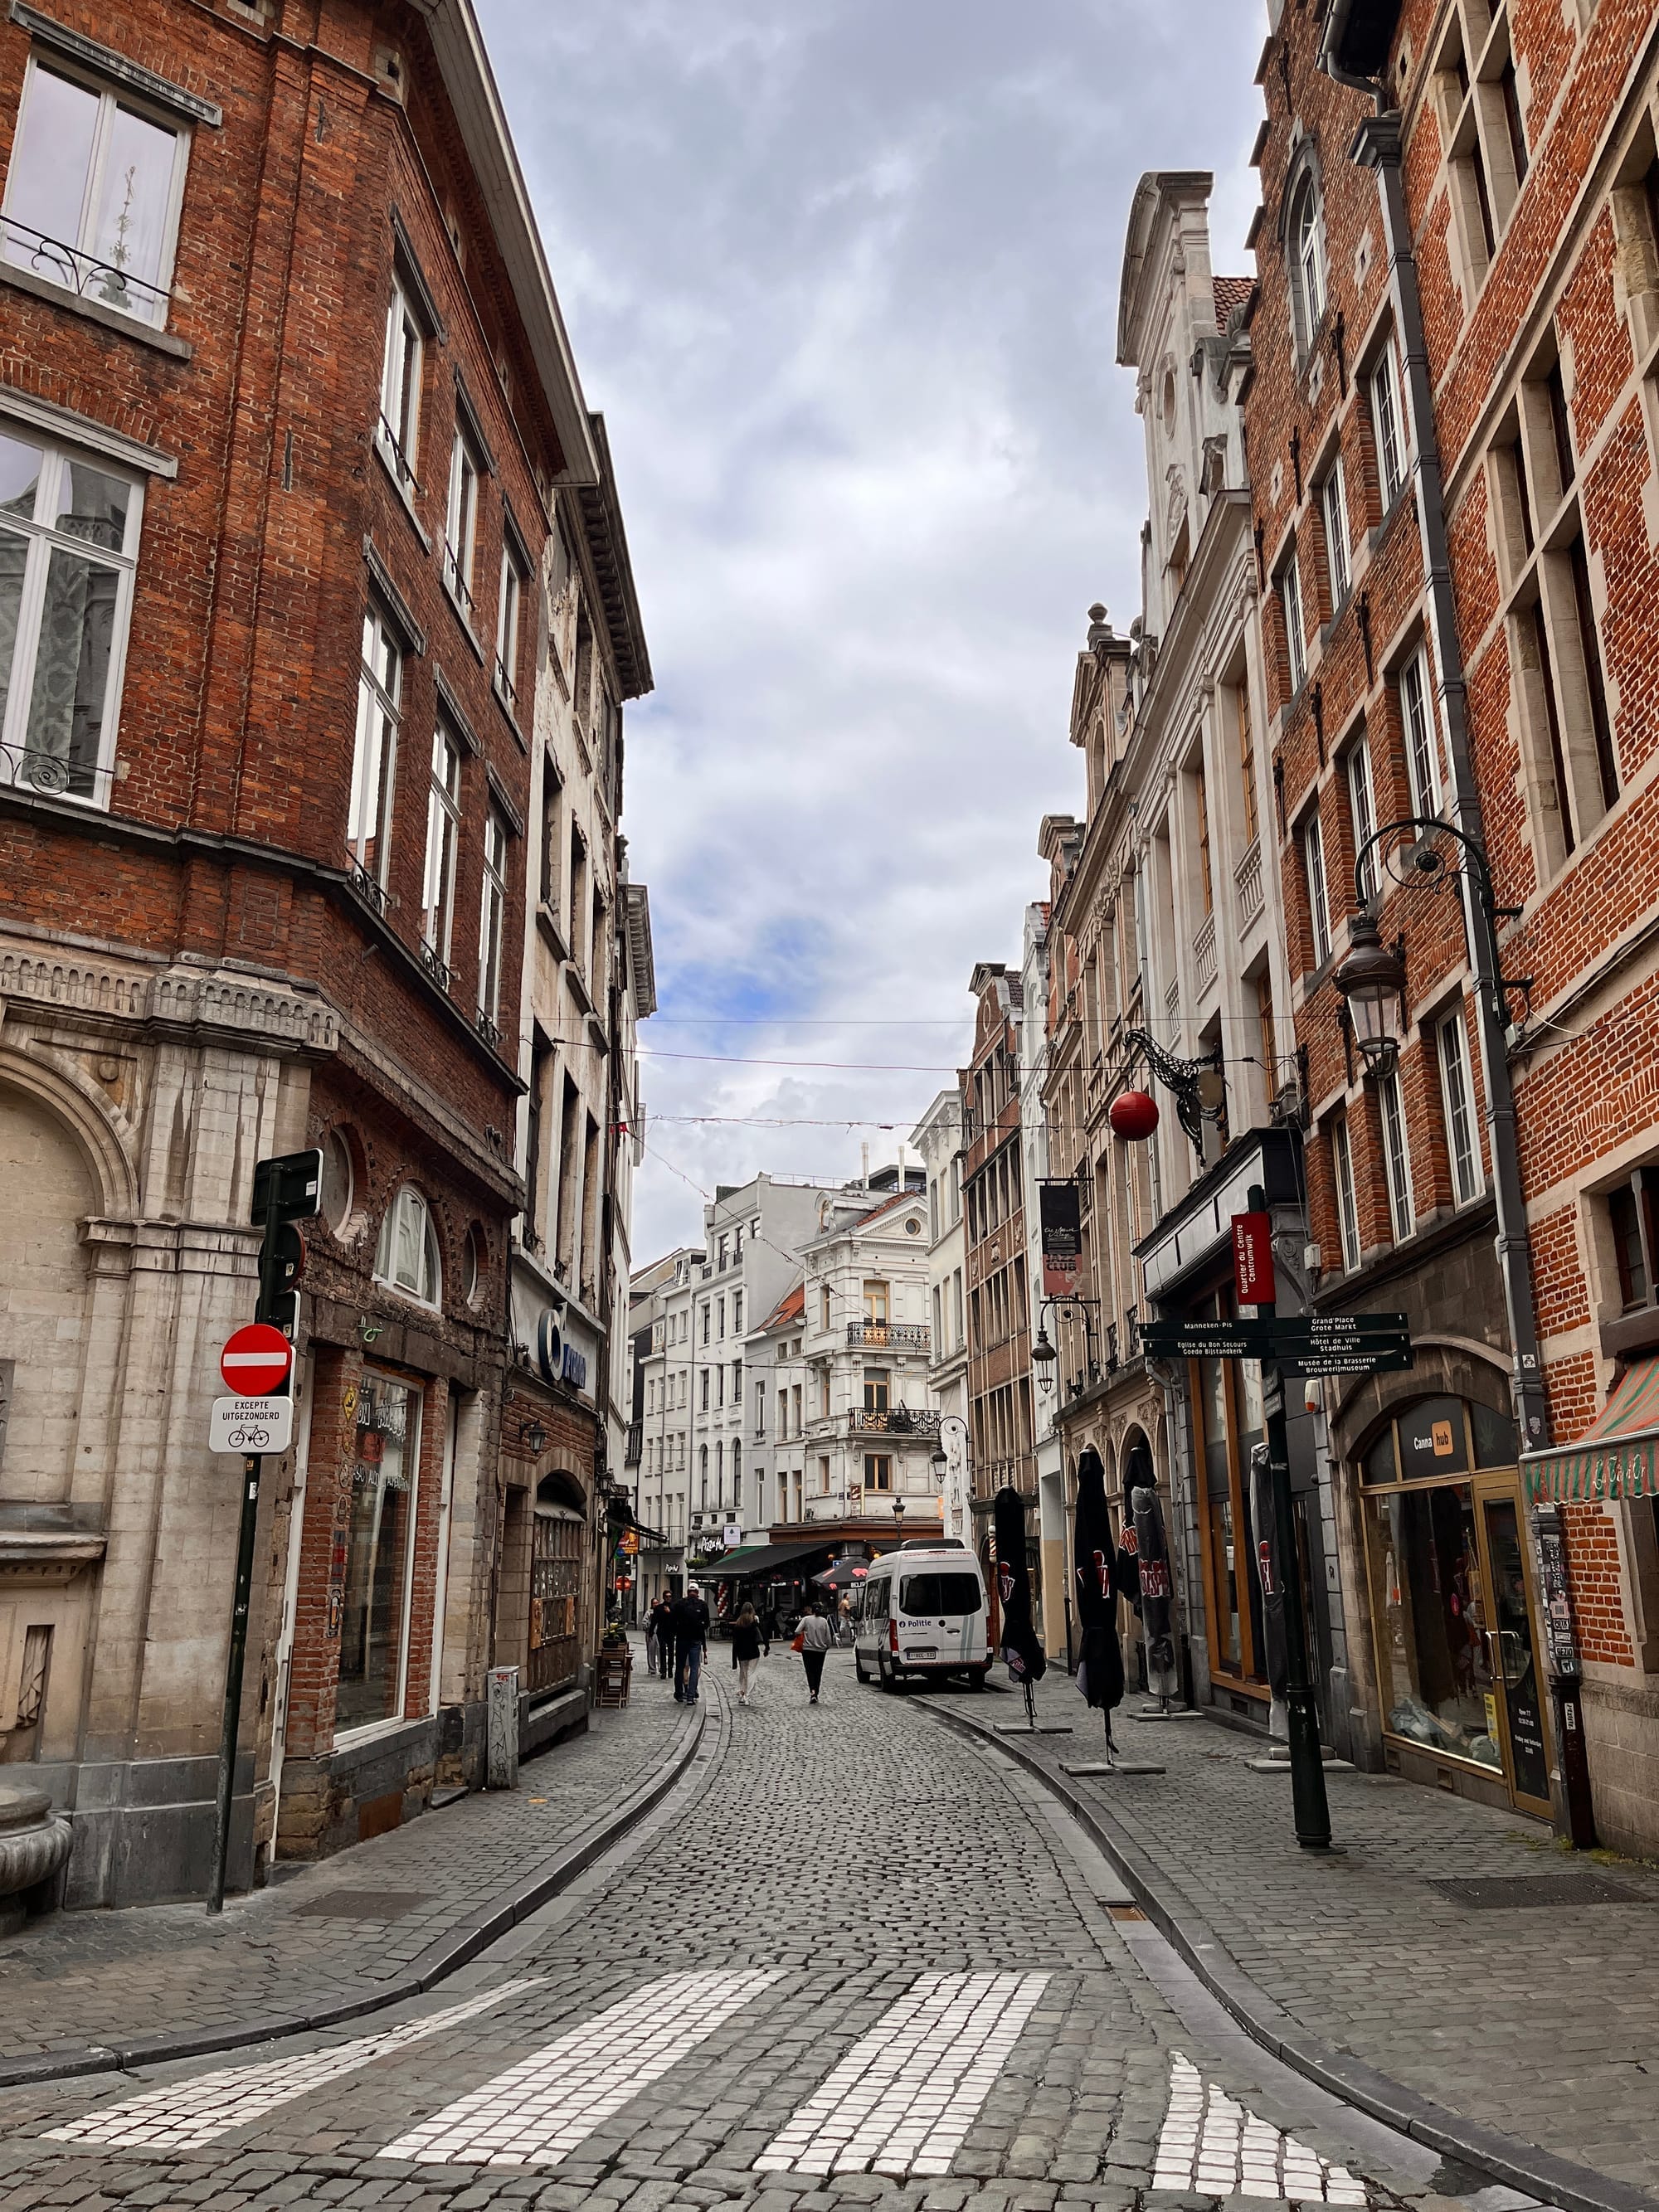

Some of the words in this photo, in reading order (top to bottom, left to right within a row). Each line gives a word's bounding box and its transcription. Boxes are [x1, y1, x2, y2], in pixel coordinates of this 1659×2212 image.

[1238, 1252, 1245, 1261] du
[1245, 1234, 1256, 1282] Centrumwijk
[1047, 1262, 1077, 1271] CLUB
[1240, 1264, 1248, 1294] Quartier
[1204, 1348, 1243, 1356] Bijstandkerk
[1298, 1359, 1321, 1367] Musée
[1306, 1364, 1370, 1373] Brouwerijmuseum
[222, 1412, 280, 1420] UITGEZONDERD
[1413, 1437, 1433, 1450] Canna
[1436, 1431, 1449, 1447] hub
[701, 1536, 716, 1553] Pizza
